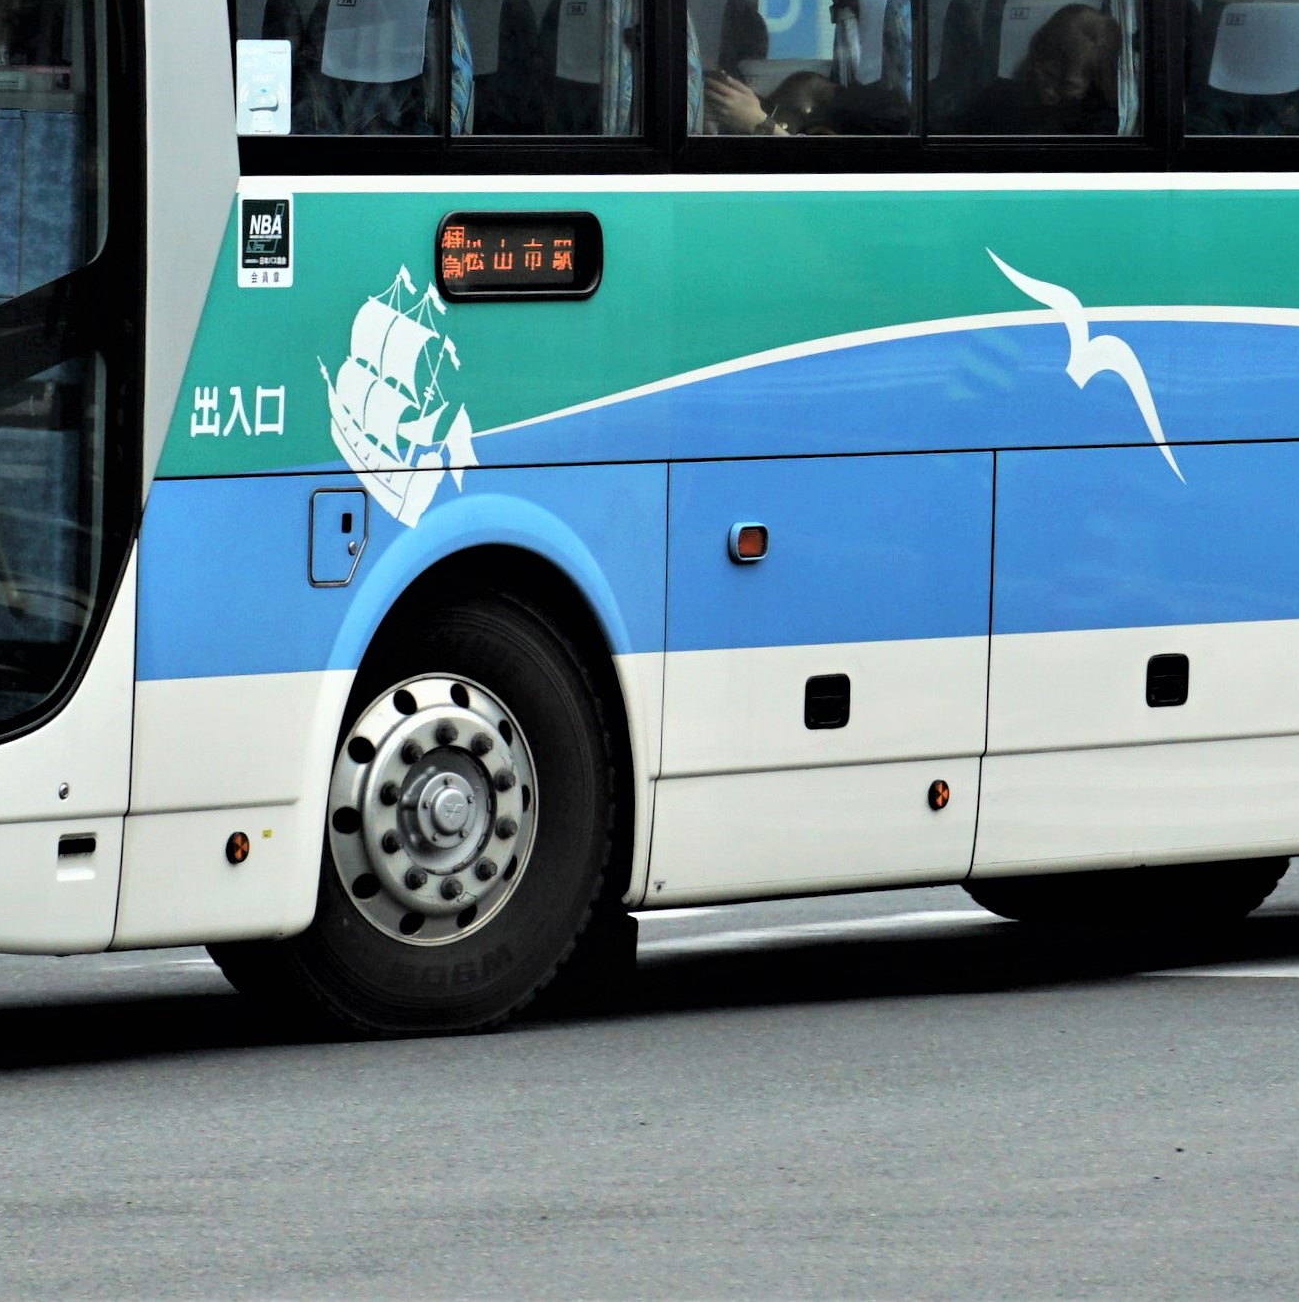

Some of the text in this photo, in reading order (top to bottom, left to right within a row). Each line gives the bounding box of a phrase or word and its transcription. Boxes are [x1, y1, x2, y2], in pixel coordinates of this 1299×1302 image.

[249, 214, 282, 235] NBA
[190, 385, 286, 437] 出入口
